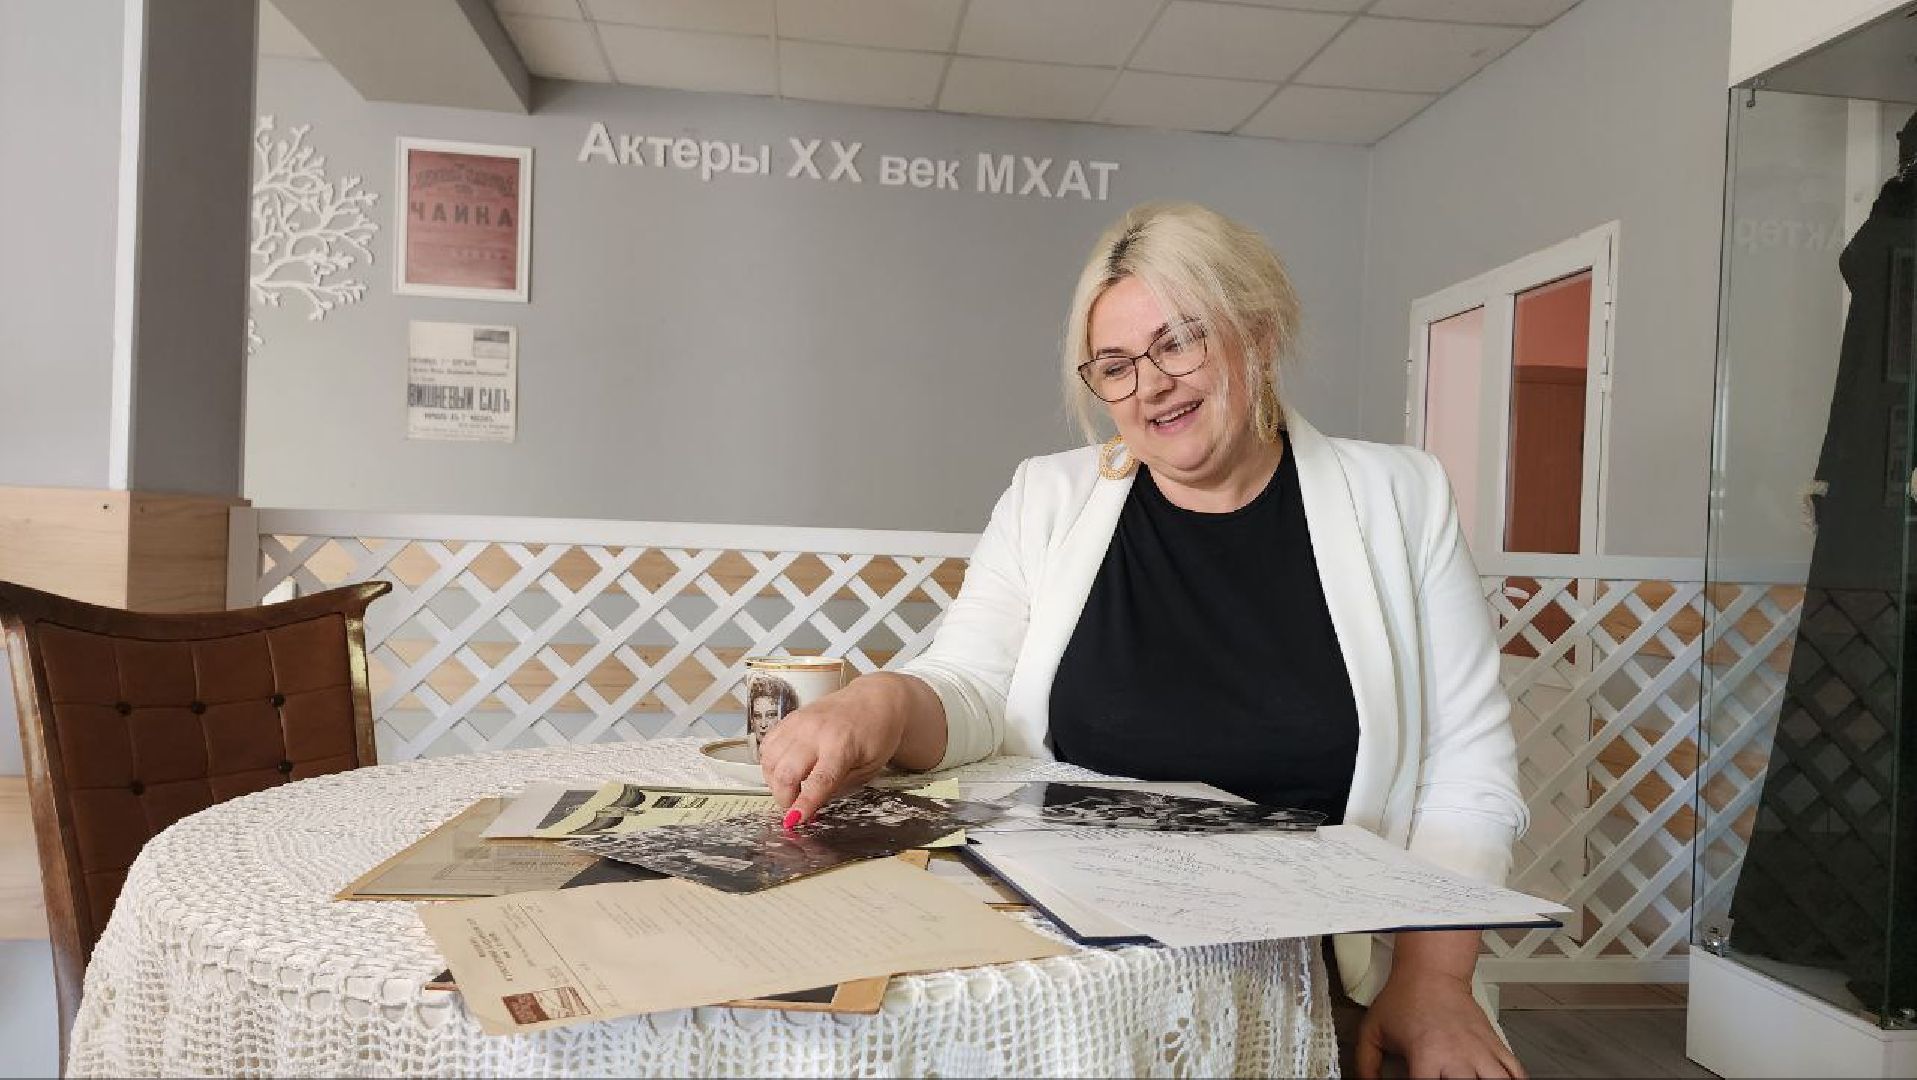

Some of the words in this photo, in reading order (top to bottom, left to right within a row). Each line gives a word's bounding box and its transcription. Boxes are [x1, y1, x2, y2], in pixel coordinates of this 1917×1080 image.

[577, 121, 771, 182] Актеры
[880, 153, 960, 191] век
[976, 152, 1119, 201] МХАТ
